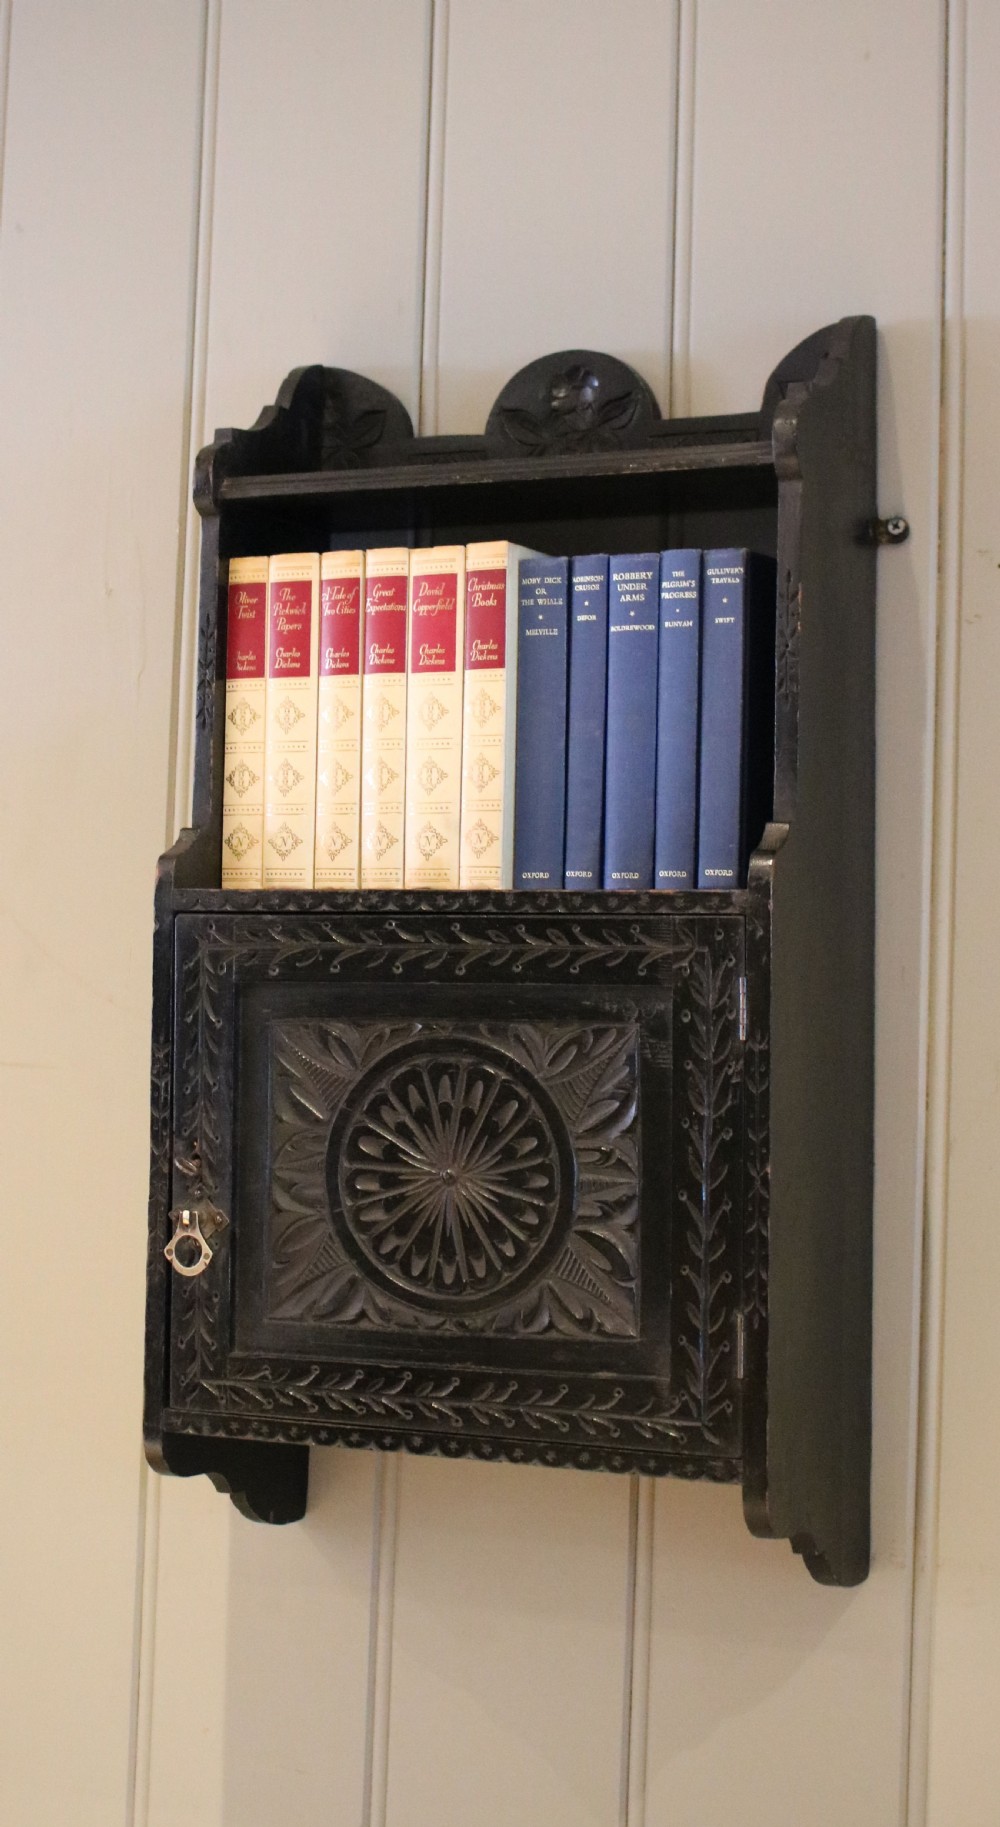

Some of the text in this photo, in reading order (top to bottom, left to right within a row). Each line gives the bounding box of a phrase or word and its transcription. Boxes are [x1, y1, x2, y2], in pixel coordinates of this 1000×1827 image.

[612, 572, 654, 581] ROBBERY
[419, 582, 446, 596] David
[468, 577, 504, 592] Christmas
[618, 583, 648, 591] UNDER
[280, 588, 296, 602] The
[331, 586, 345, 600] Tale
[346, 586, 359, 604] of
[372, 584, 396, 602] Great
[620, 594, 646, 602] ARMS
[472, 592, 497, 608] Books
[274, 602, 306, 616] Pickwick
[323, 600, 356, 616] Two Cities
[365, 598, 407, 616] Expectations
[413, 598, 456, 616] Copperfield
[277, 617, 302, 634] Papers
[370, 643, 394, 654] Charles
[420, 643, 446, 654] Charles
[472, 640, 498, 650] Charles
[236, 650, 256, 660] harles
[276, 648, 300, 658] Charles
[326, 648, 350, 658] Charles
[470, 650, 498, 662] Dickens
[275, 658, 300, 668] Dickens
[325, 658, 349, 670] Dickens
[370, 654, 396, 665] Dickens
[419, 654, 445, 666] Dickens
